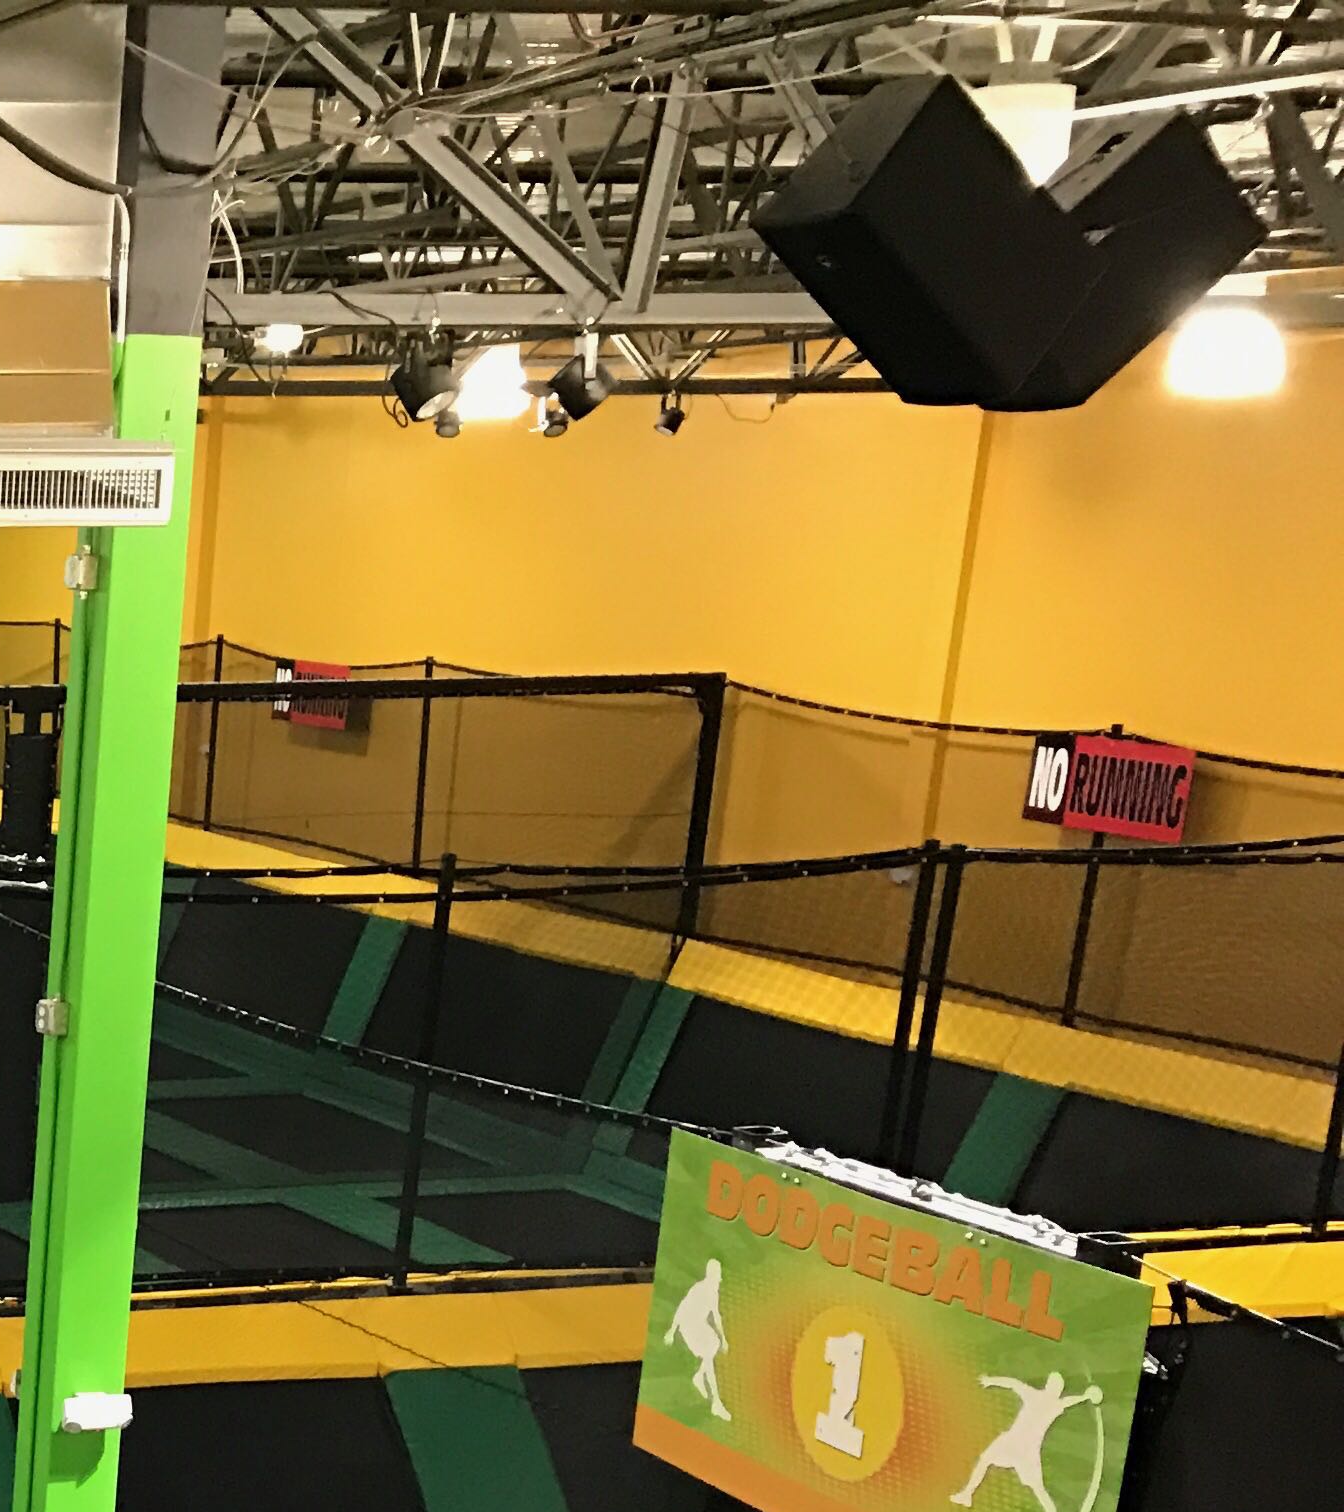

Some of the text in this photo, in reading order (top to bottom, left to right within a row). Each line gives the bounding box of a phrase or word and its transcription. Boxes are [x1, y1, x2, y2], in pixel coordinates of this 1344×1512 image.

[1028, 745, 1188, 829] NO RUNNING
[706, 1160, 1065, 1342] DODGEBALL
[814, 1331, 865, 1460] 1
